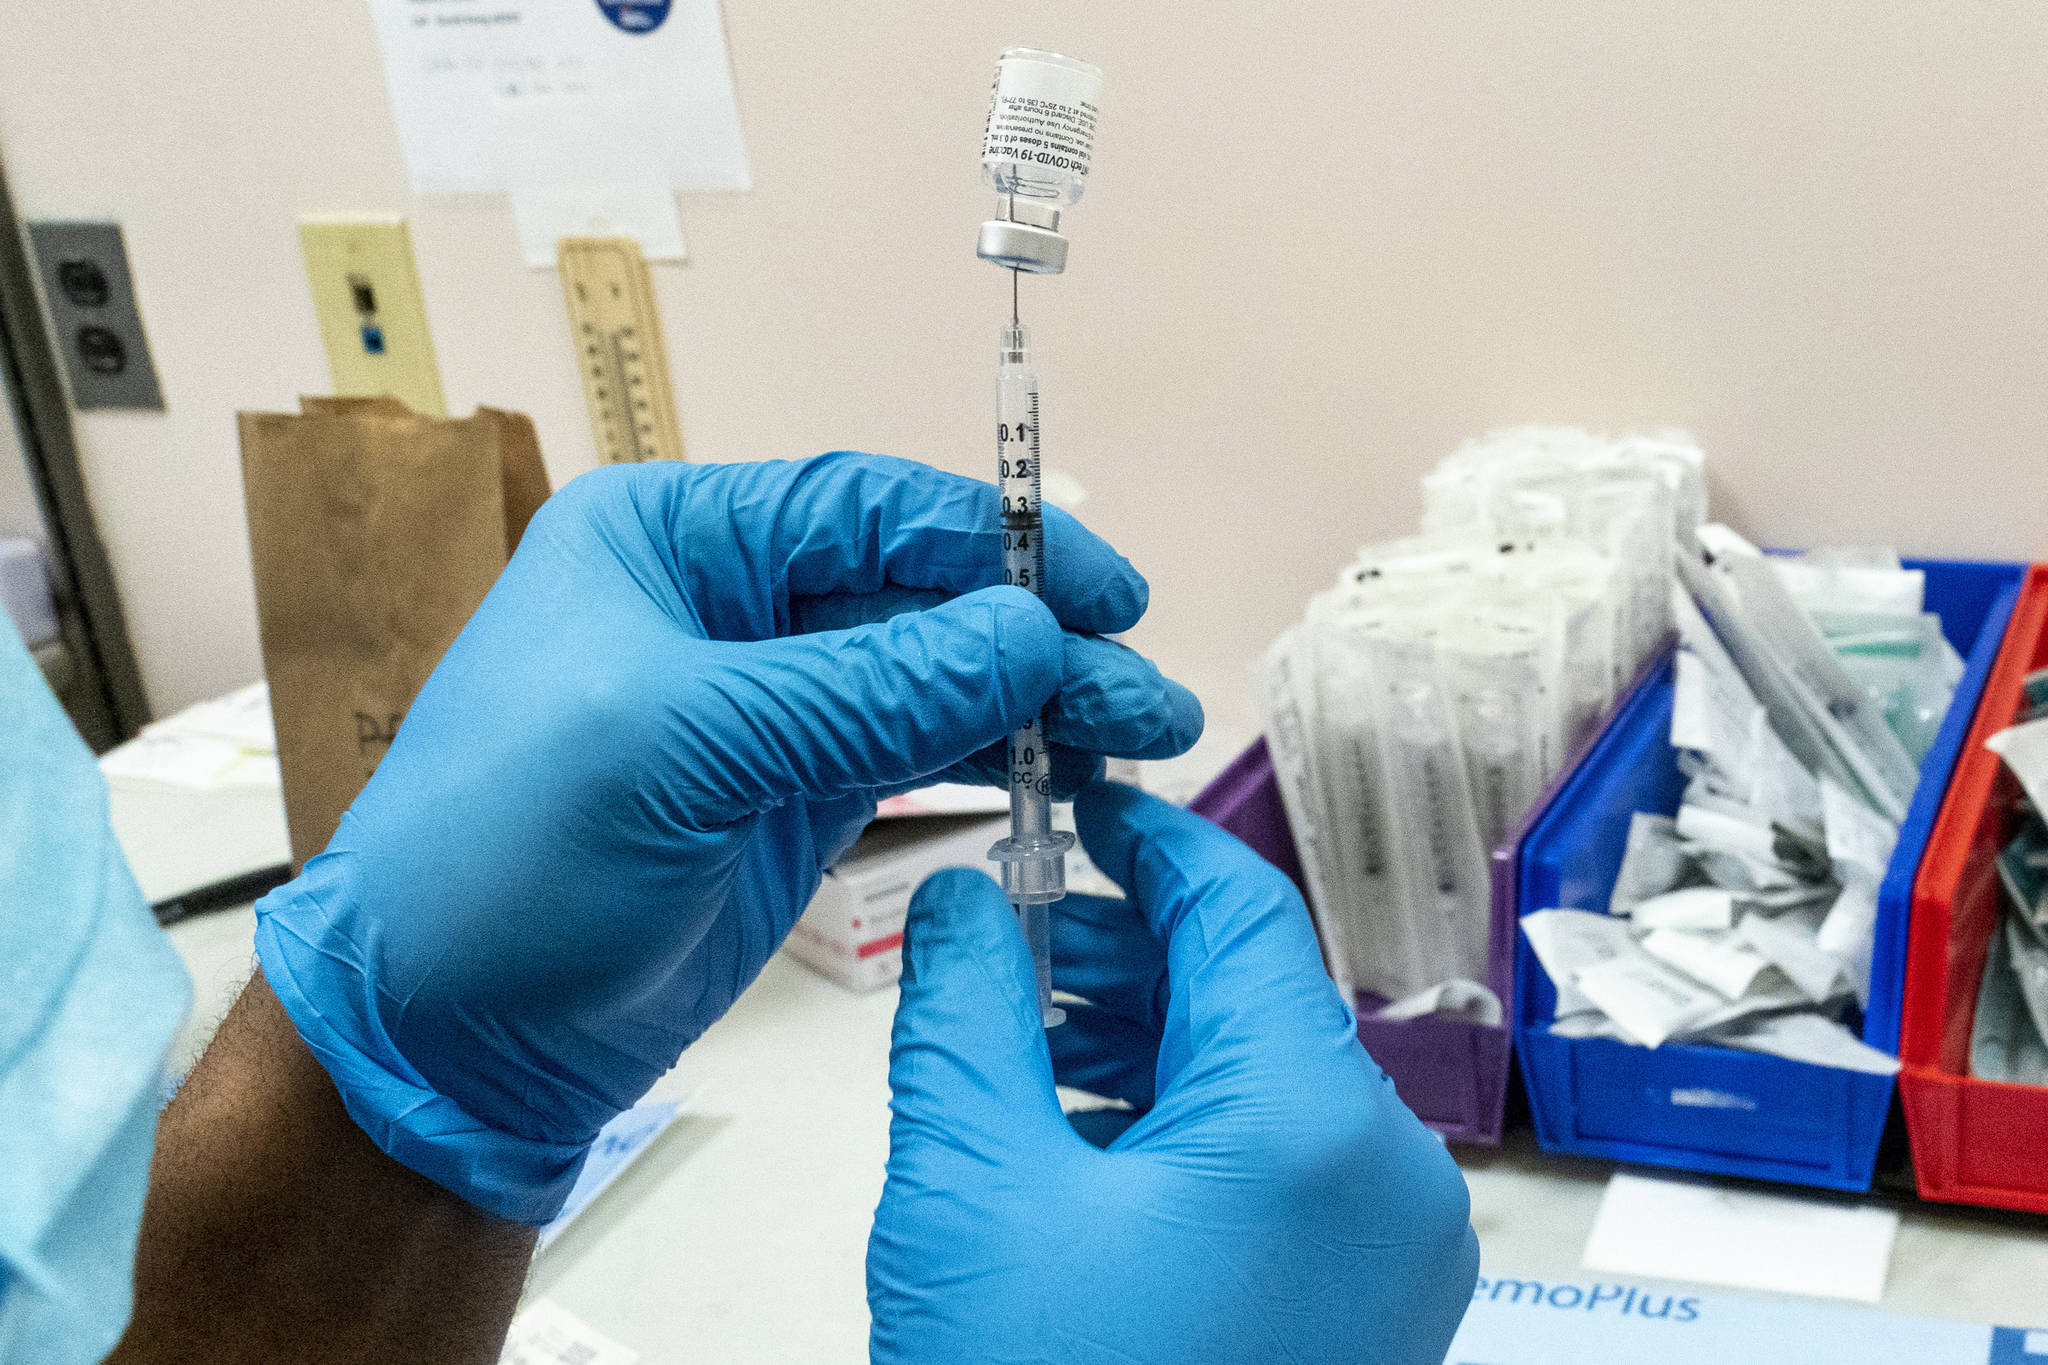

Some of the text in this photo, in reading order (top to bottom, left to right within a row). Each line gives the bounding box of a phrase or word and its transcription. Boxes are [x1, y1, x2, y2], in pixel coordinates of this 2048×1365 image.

[1024, 105, 1043, 115] hours
[1051, 111, 1076, 123] Discard
[1047, 121, 1060, 129] Use
[1020, 137, 1041, 147] doses
[1046, 131, 1074, 144] Contains
[1044, 141, 1049, 149] 5
[1051, 143, 1078, 155] contains
[989, 146, 1018, 159] Vaccine
[1021, 149, 1069, 169] COVID-19
[1000, 423, 1025, 442] 0.1
[1001, 459, 1028, 479] 0.2
[1002, 496, 1028, 515] 0.3
[1003, 533, 1029, 551] 0.4
[1004, 569, 1030, 587] 0.5
[1010, 747, 1034, 765] 1.0
